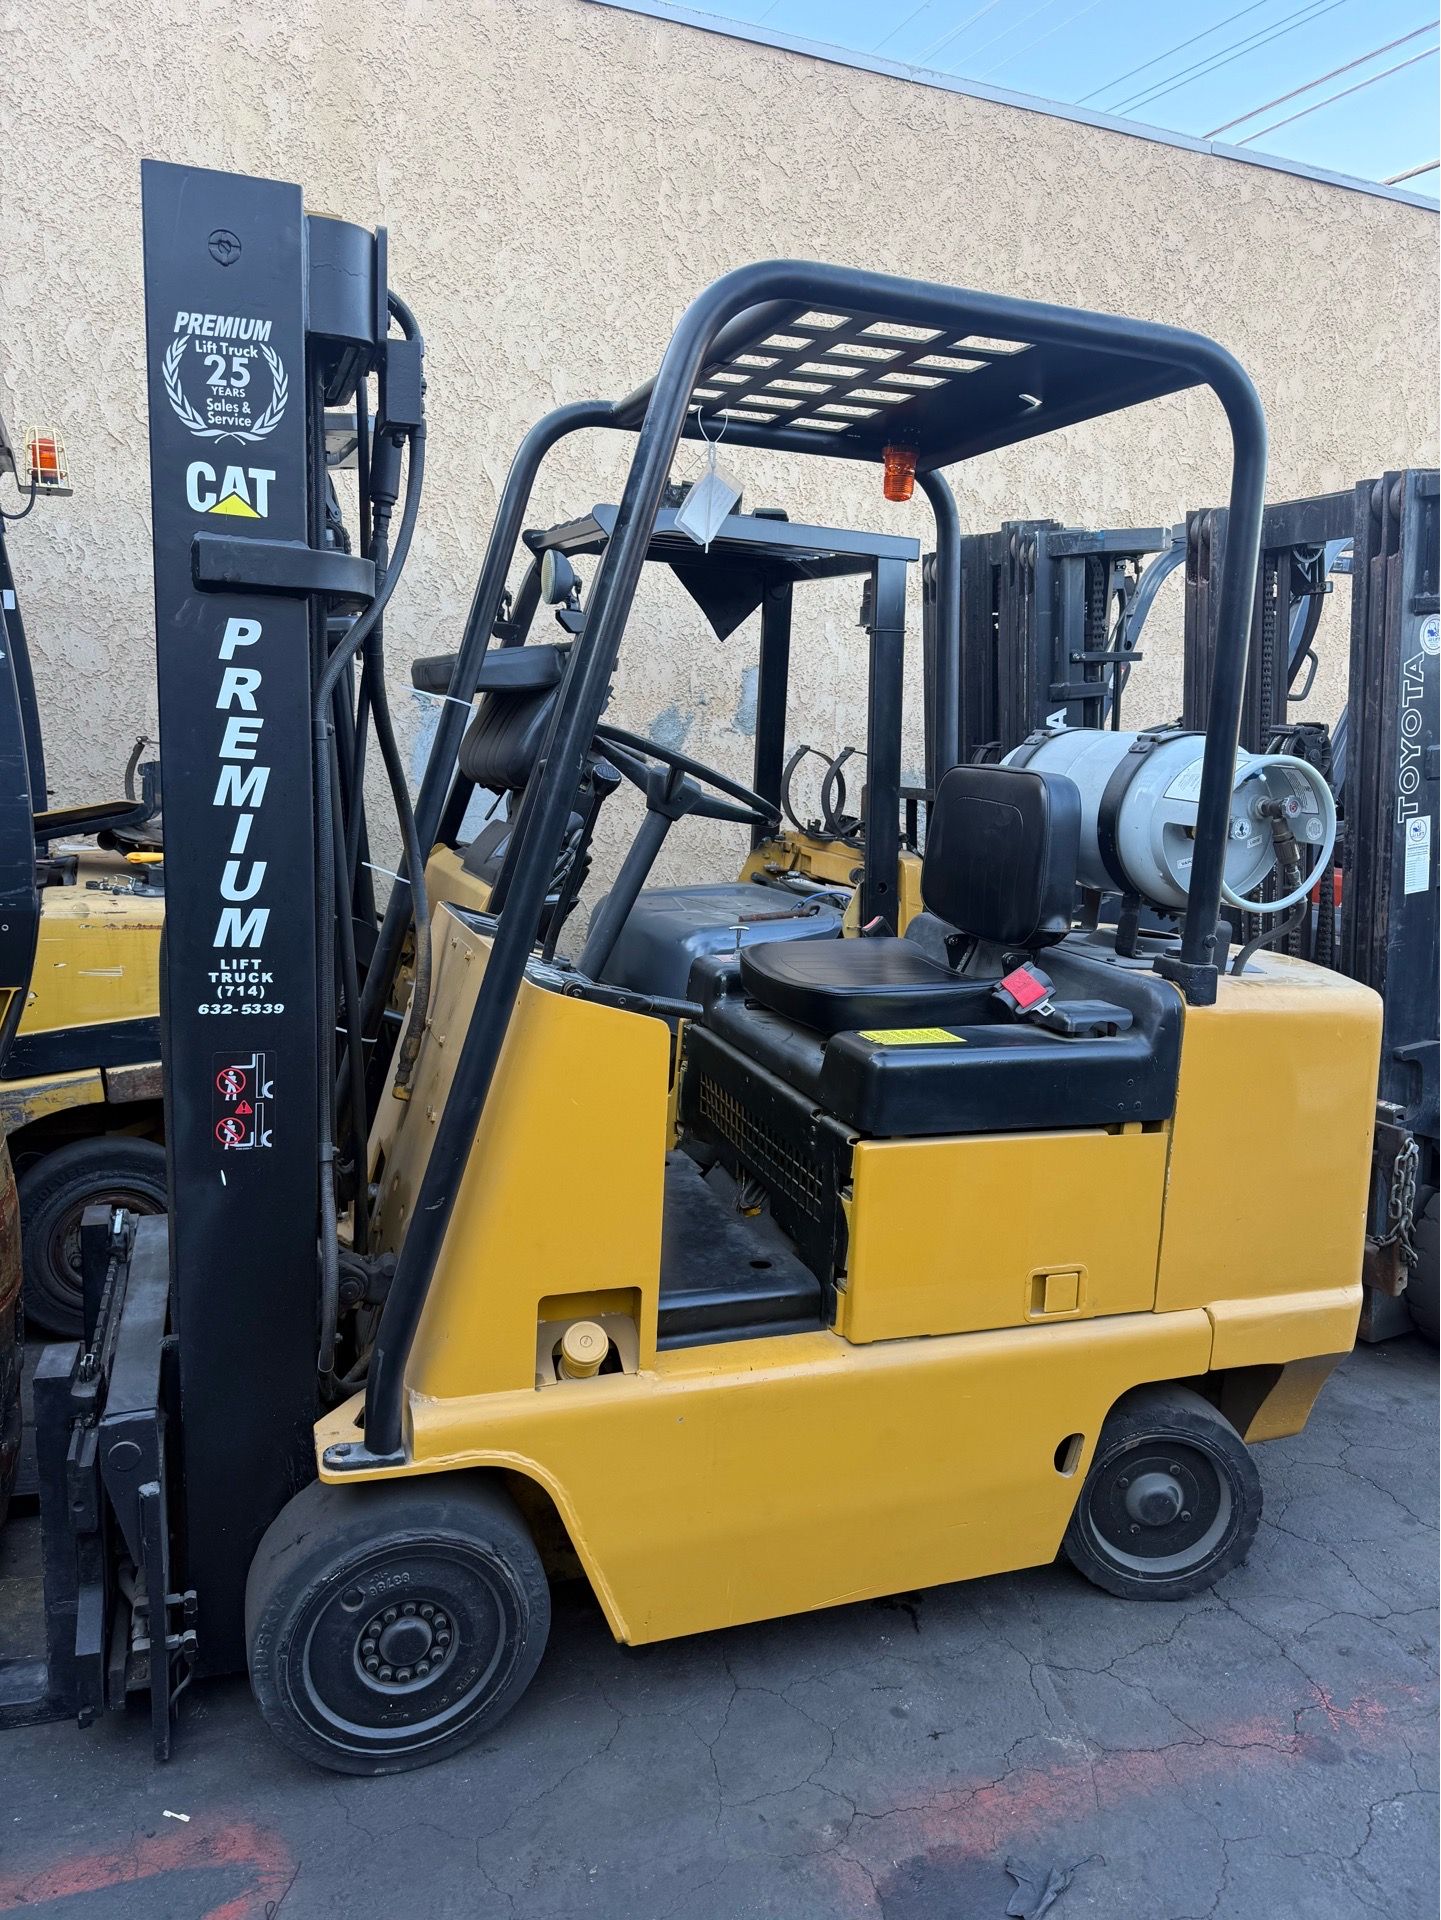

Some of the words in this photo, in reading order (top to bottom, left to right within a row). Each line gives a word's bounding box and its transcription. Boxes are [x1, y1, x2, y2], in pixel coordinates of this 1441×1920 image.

[173, 311, 273, 342] PREMIUM
[195, 340, 218, 354] Lift
[219, 342, 259, 358] Truck
[203, 354, 251, 388] 25
[211, 386, 246, 398] YEARS
[206, 398, 239, 413] Sales
[242, 401, 251, 414] &
[207, 412, 252, 427] Service
[186, 461, 276, 518] CAT
[1397, 650, 1425, 824] TOYOTA
[213, 617, 271, 948] PREMIUM
[220, 959, 262, 970] LIFT
[208, 972, 274, 983] TRUCK
[217, 985, 265, 999] (714)
[198, 1003, 285, 1015] 632-5339
